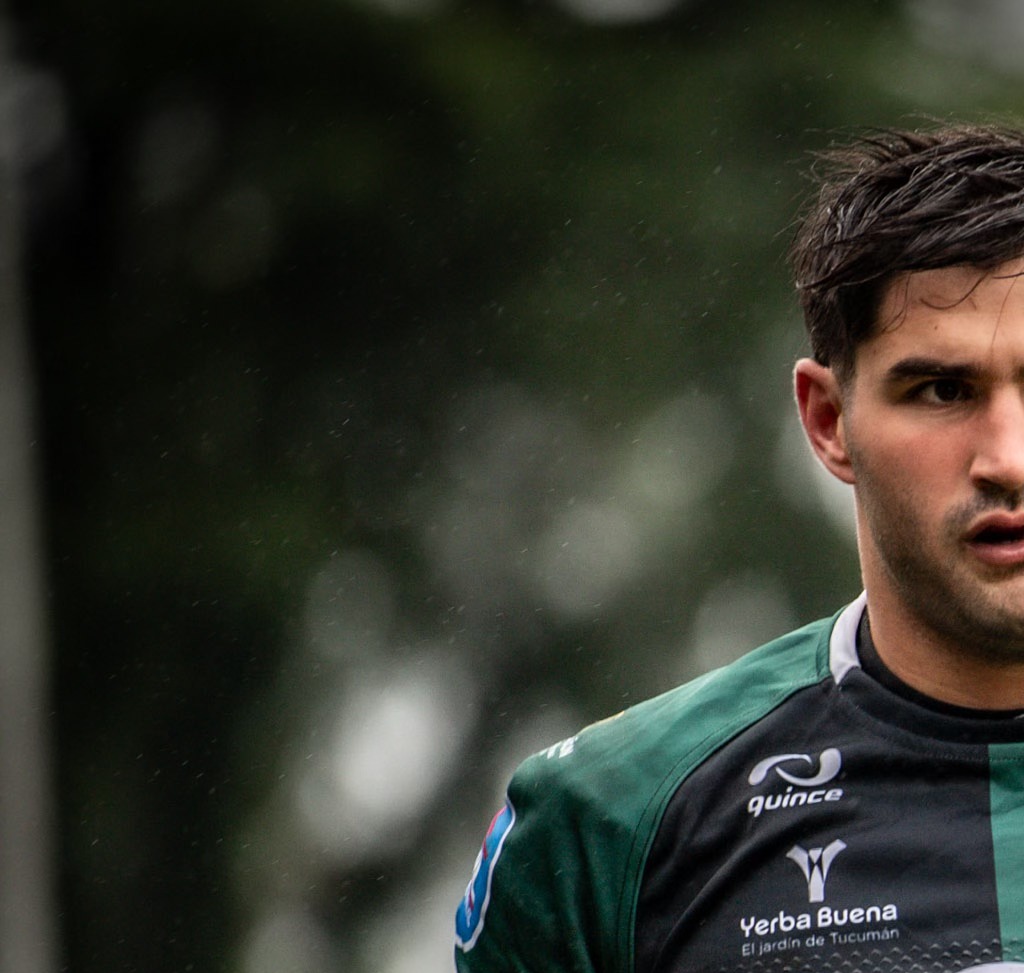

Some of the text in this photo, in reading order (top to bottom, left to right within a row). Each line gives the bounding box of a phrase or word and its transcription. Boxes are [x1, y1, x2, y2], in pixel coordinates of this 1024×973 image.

[747, 786, 844, 818] quince
[740, 903, 898, 938] Yerba Buena
[741, 943, 755, 957] El
[805, 933, 825, 948] de
[829, 926, 900, 946] Tucumán
